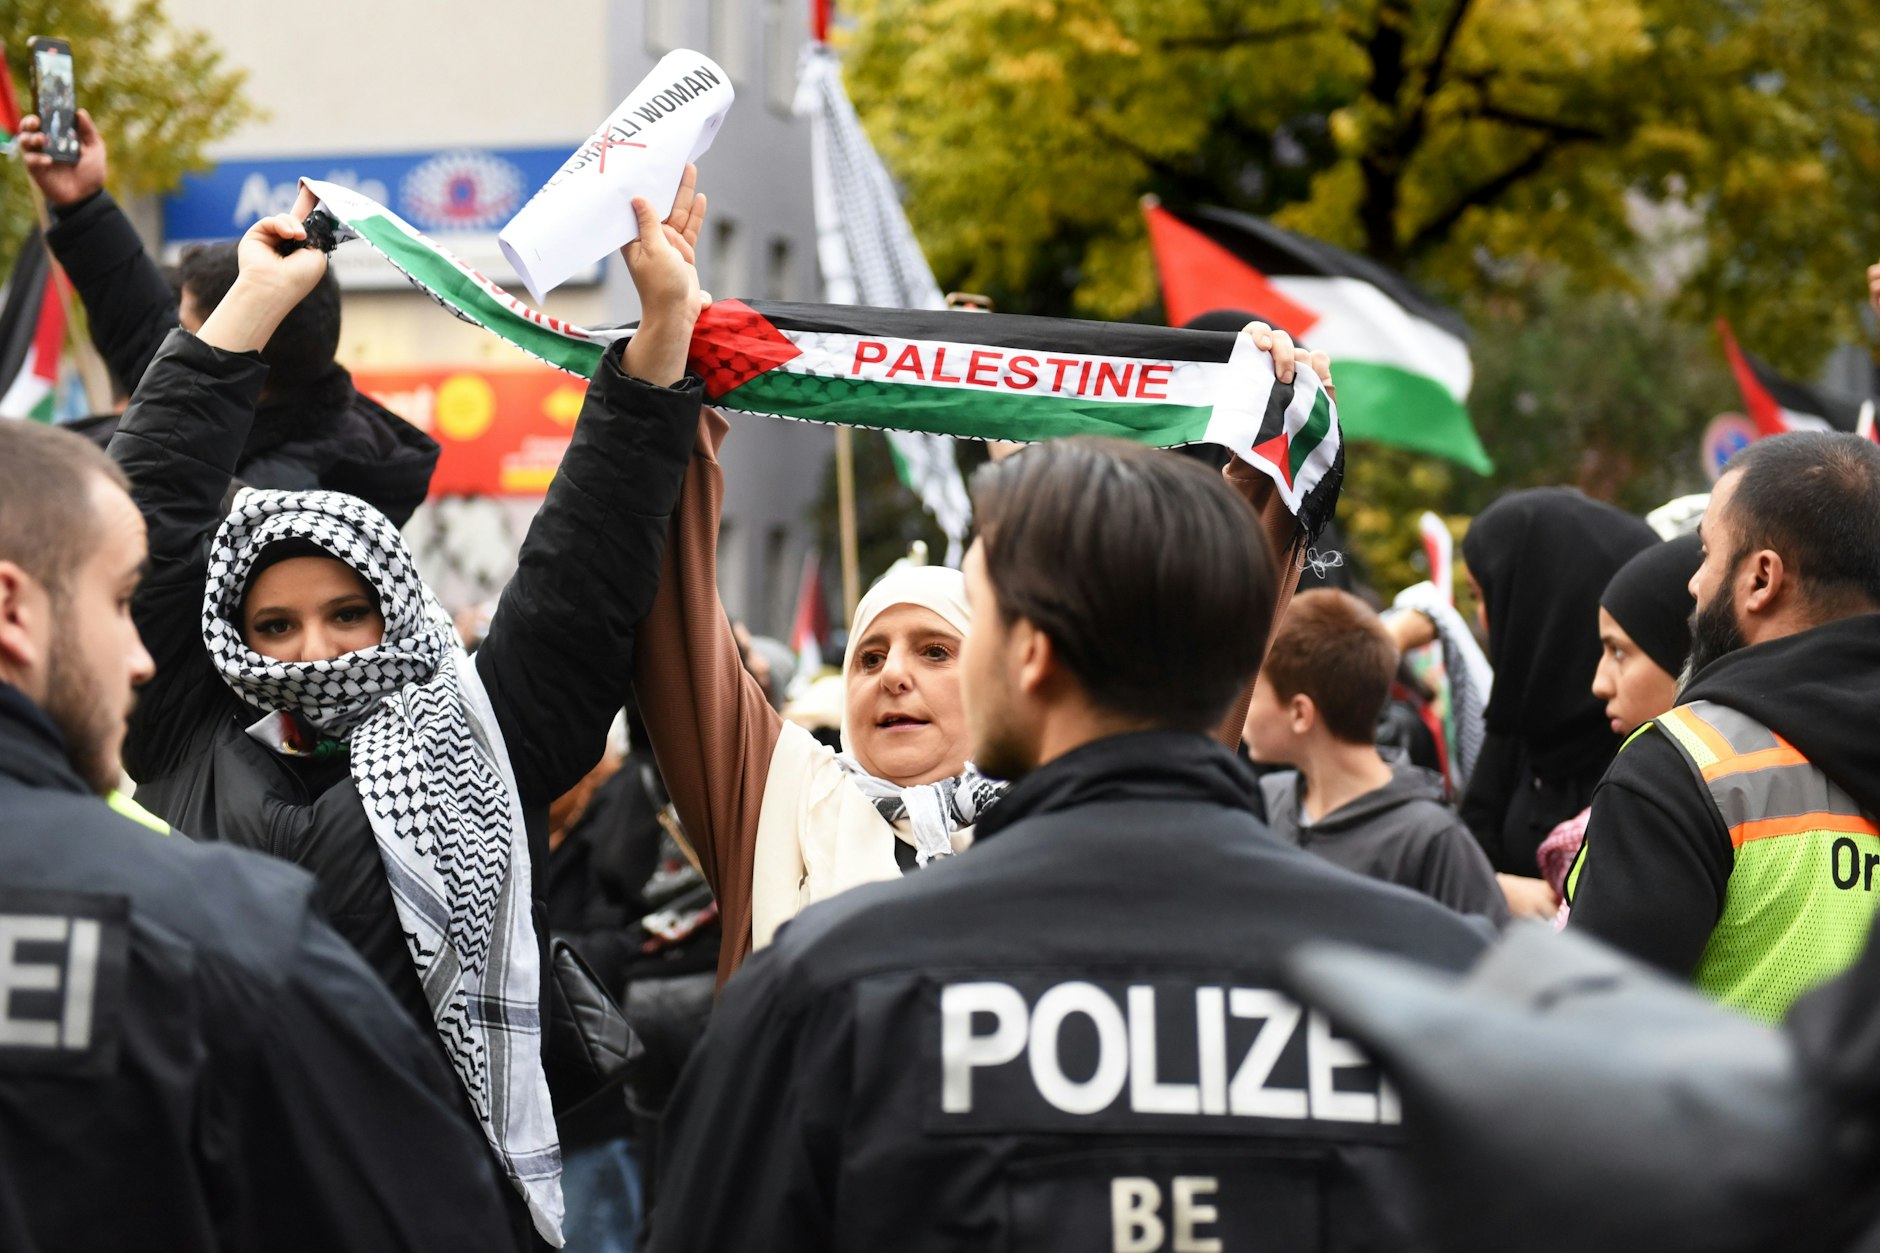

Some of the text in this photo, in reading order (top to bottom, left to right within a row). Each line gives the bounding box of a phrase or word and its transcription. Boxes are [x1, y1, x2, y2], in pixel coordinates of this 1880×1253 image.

[632, 65, 721, 124] WOMAN
[850, 340, 1174, 400] PALESTINE
[1831, 837, 1880, 892] Or
[1110, 1175, 1223, 1253] BE
